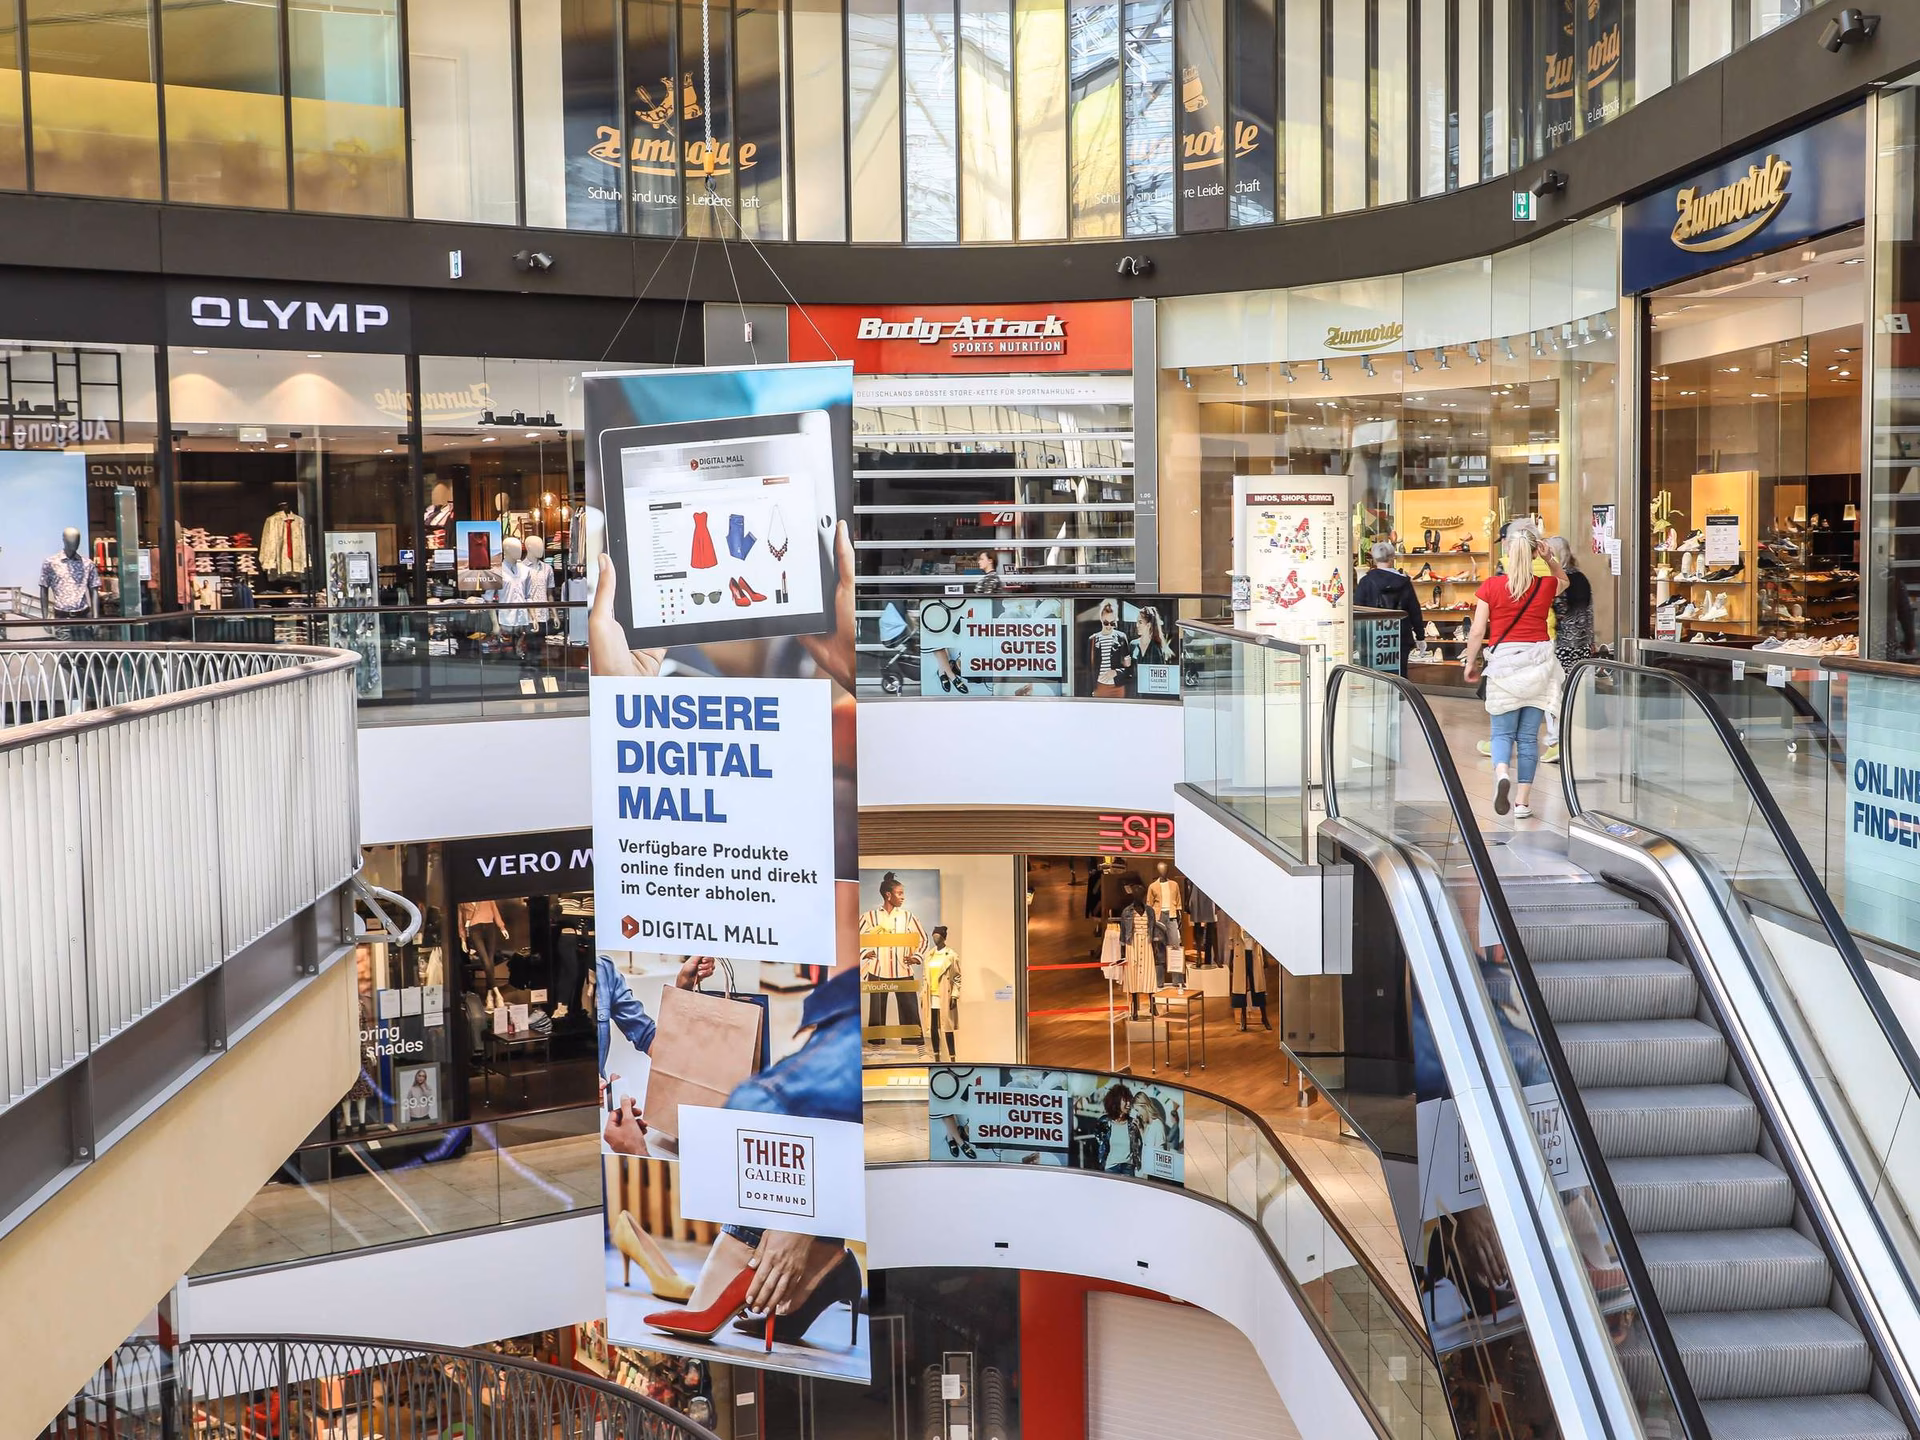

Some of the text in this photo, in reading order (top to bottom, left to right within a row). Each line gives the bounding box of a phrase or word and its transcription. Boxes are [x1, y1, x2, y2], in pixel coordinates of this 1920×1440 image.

[1671, 153, 1792, 248] Zumnorde
[191, 296, 389, 333] OLYMP
[857, 314, 1067, 344] Body Attack
[1324, 321, 1403, 350] Zumnorde
[952, 340, 1061, 353] SPORTS NUTRITION
[856, 390, 913, 398] DEUTSCHLANDS
[699, 454, 745, 466] DIGITAL MALL
[1254, 494, 1280, 503] INFOS,
[1280, 494, 1308, 503] SHOPS,
[966, 623, 1057, 637] THIERISCH
[1000, 640, 1057, 655] GUTES
[970, 657, 1057, 672] SHOPPING
[1150, 669, 1168, 678] THIER
[616, 694, 780, 731] UNSERE
[617, 740, 773, 778] DIGITAL
[618, 785, 727, 823] MALL
[618, 838, 789, 861] Verfügbare Produkte
[476, 850, 561, 878] VERO
[620, 860, 818, 884] online finden und direkt
[621, 880, 776, 903] im Center abholen.
[642, 918, 779, 946] DIGITAL MALL
[366, 1039, 423, 1057] shades
[974, 1091, 1063, 1109] THIERISCH
[1007, 1108, 1064, 1125] GUTES
[978, 1124, 1063, 1142] SHOPPING
[743, 1137, 805, 1170] THIER
[1155, 1153, 1172, 1164] THIER
[745, 1167, 806, 1186] GALERIE
[746, 1191, 807, 1206] DORTMUND
